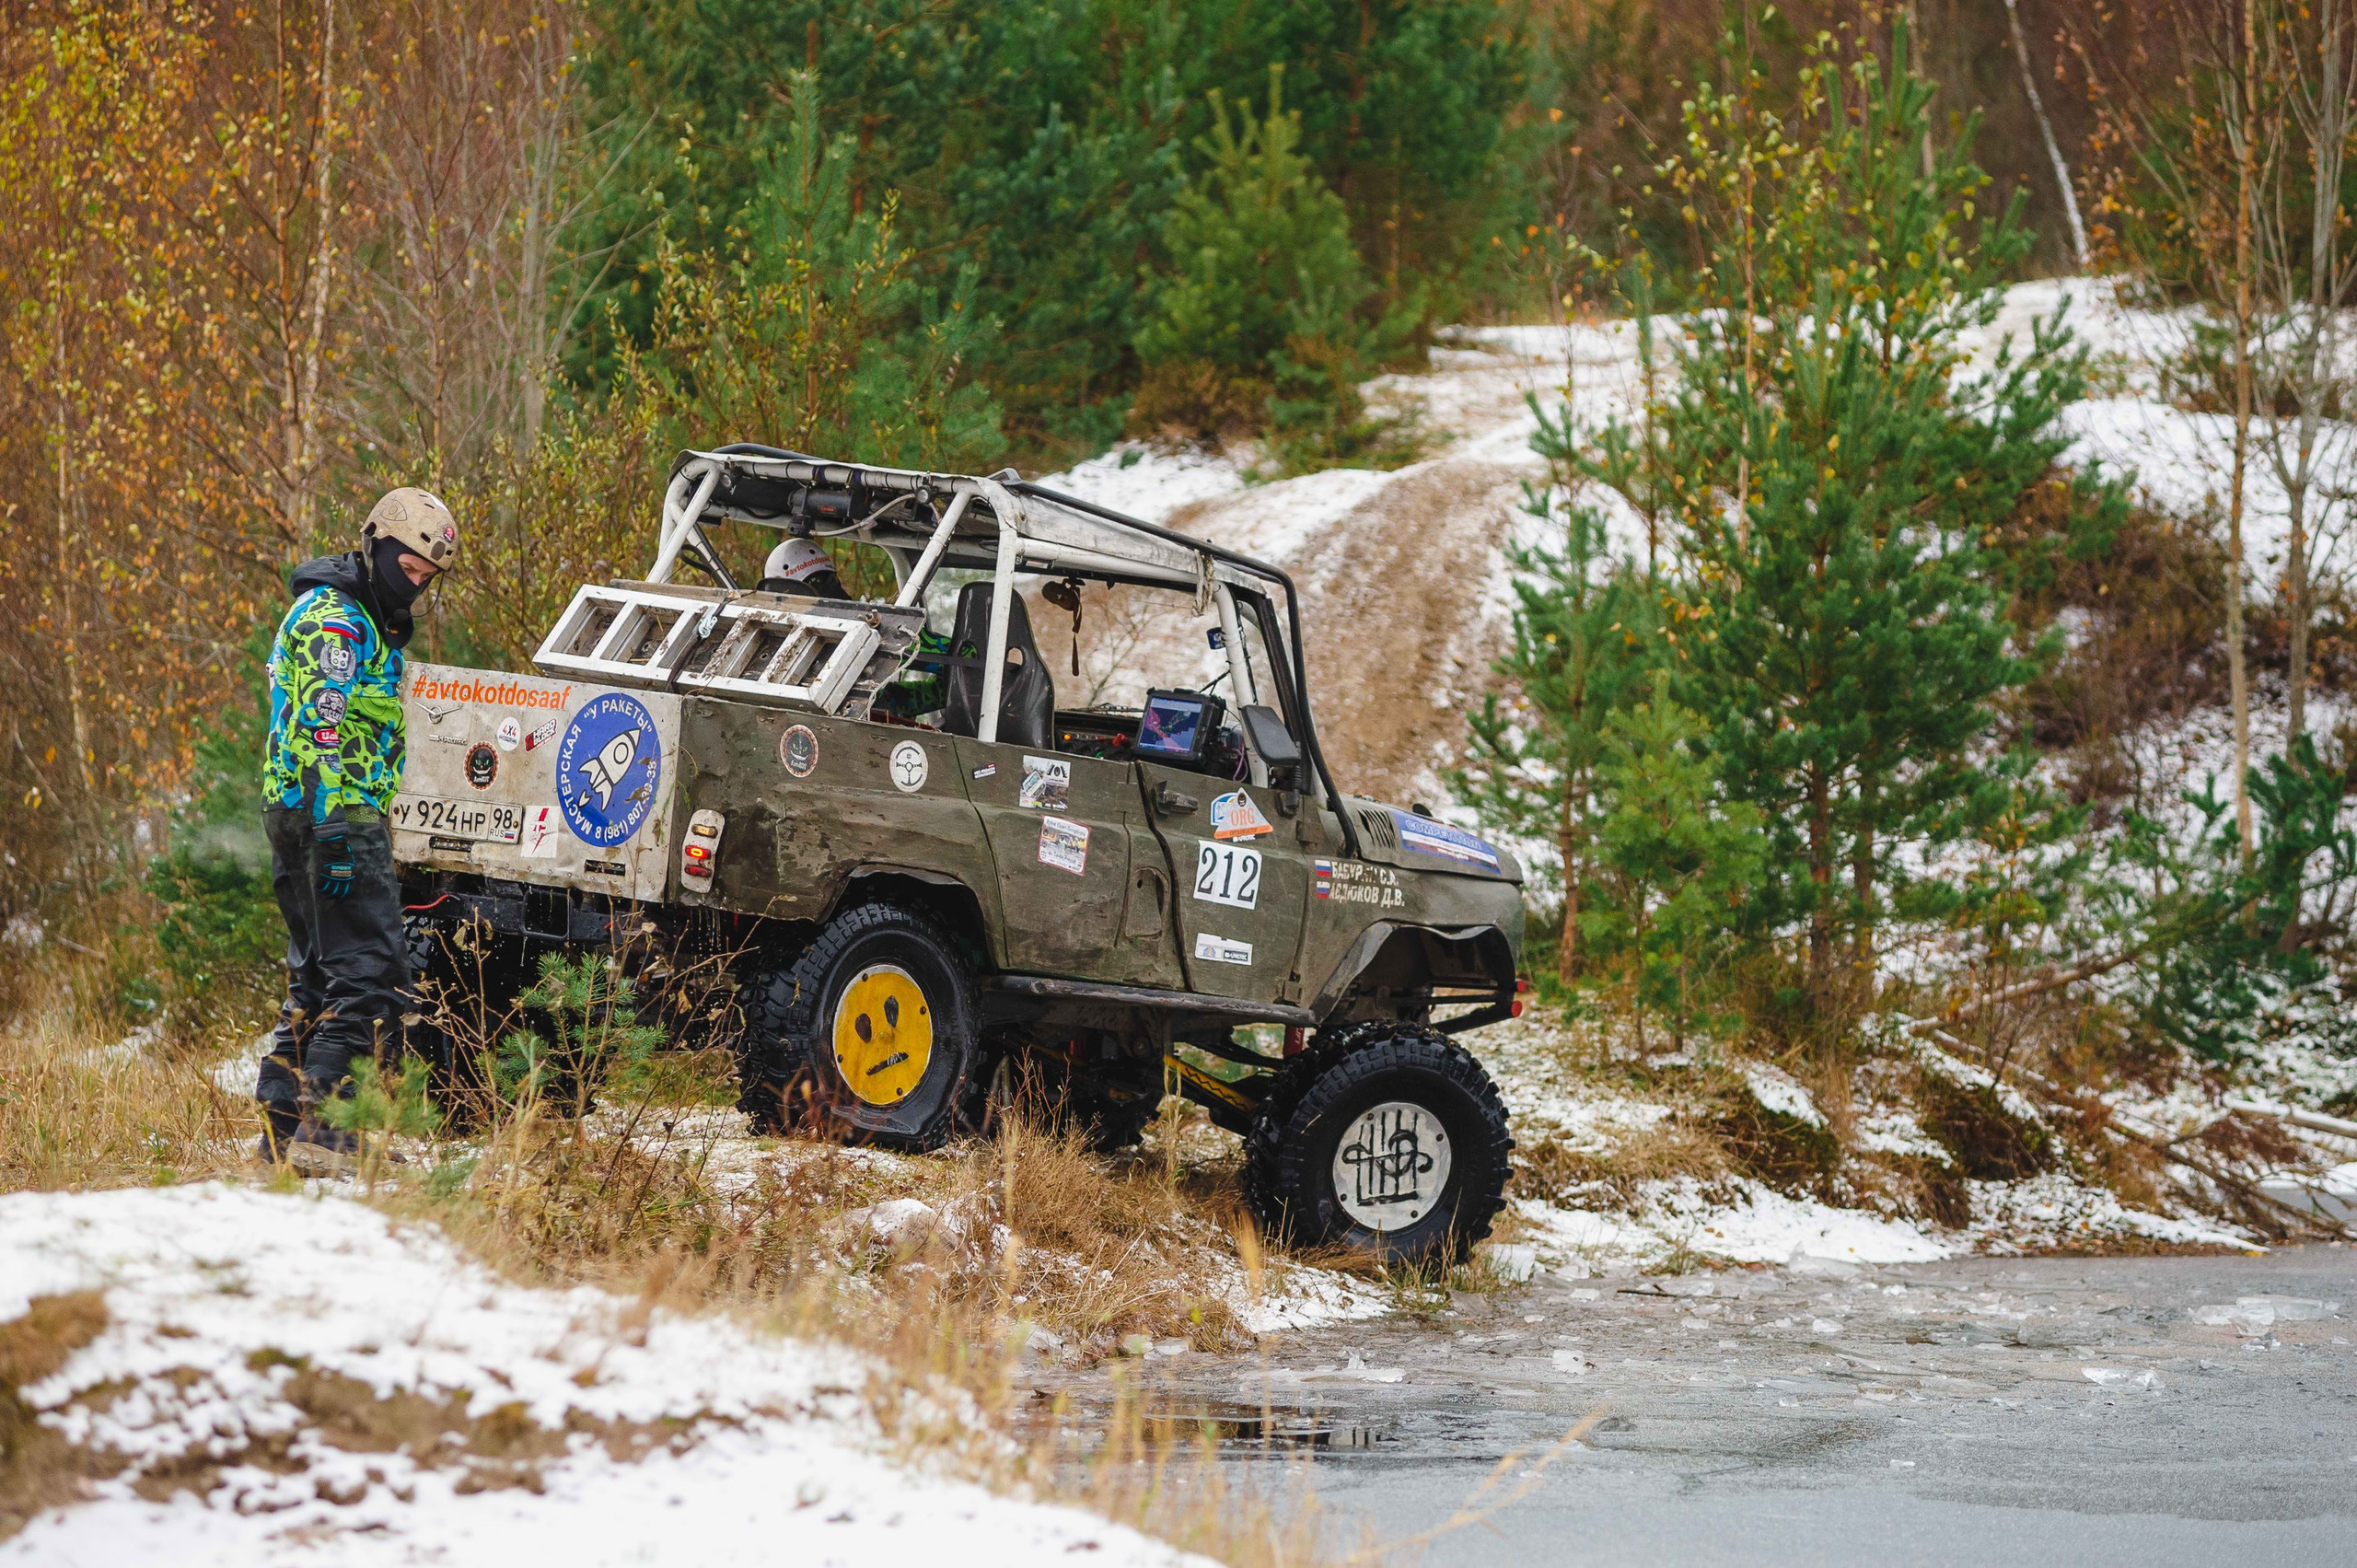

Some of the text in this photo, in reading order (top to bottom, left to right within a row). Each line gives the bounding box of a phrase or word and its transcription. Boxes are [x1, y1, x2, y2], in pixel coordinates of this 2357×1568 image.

[412, 675, 572, 709] #avtokotdosaaf
[532, 719, 556, 739] HARD
[561, 724, 593, 835] МАСТЕРСКАЯ
[493, 808, 513, 829] 98
[1230, 807, 1256, 827] ORG
[489, 829, 505, 838] RUS
[595, 826, 601, 839] 8
[604, 820, 628, 842] (981)
[1197, 846, 1259, 902] 212
[1381, 889, 1405, 909] Д.В.
